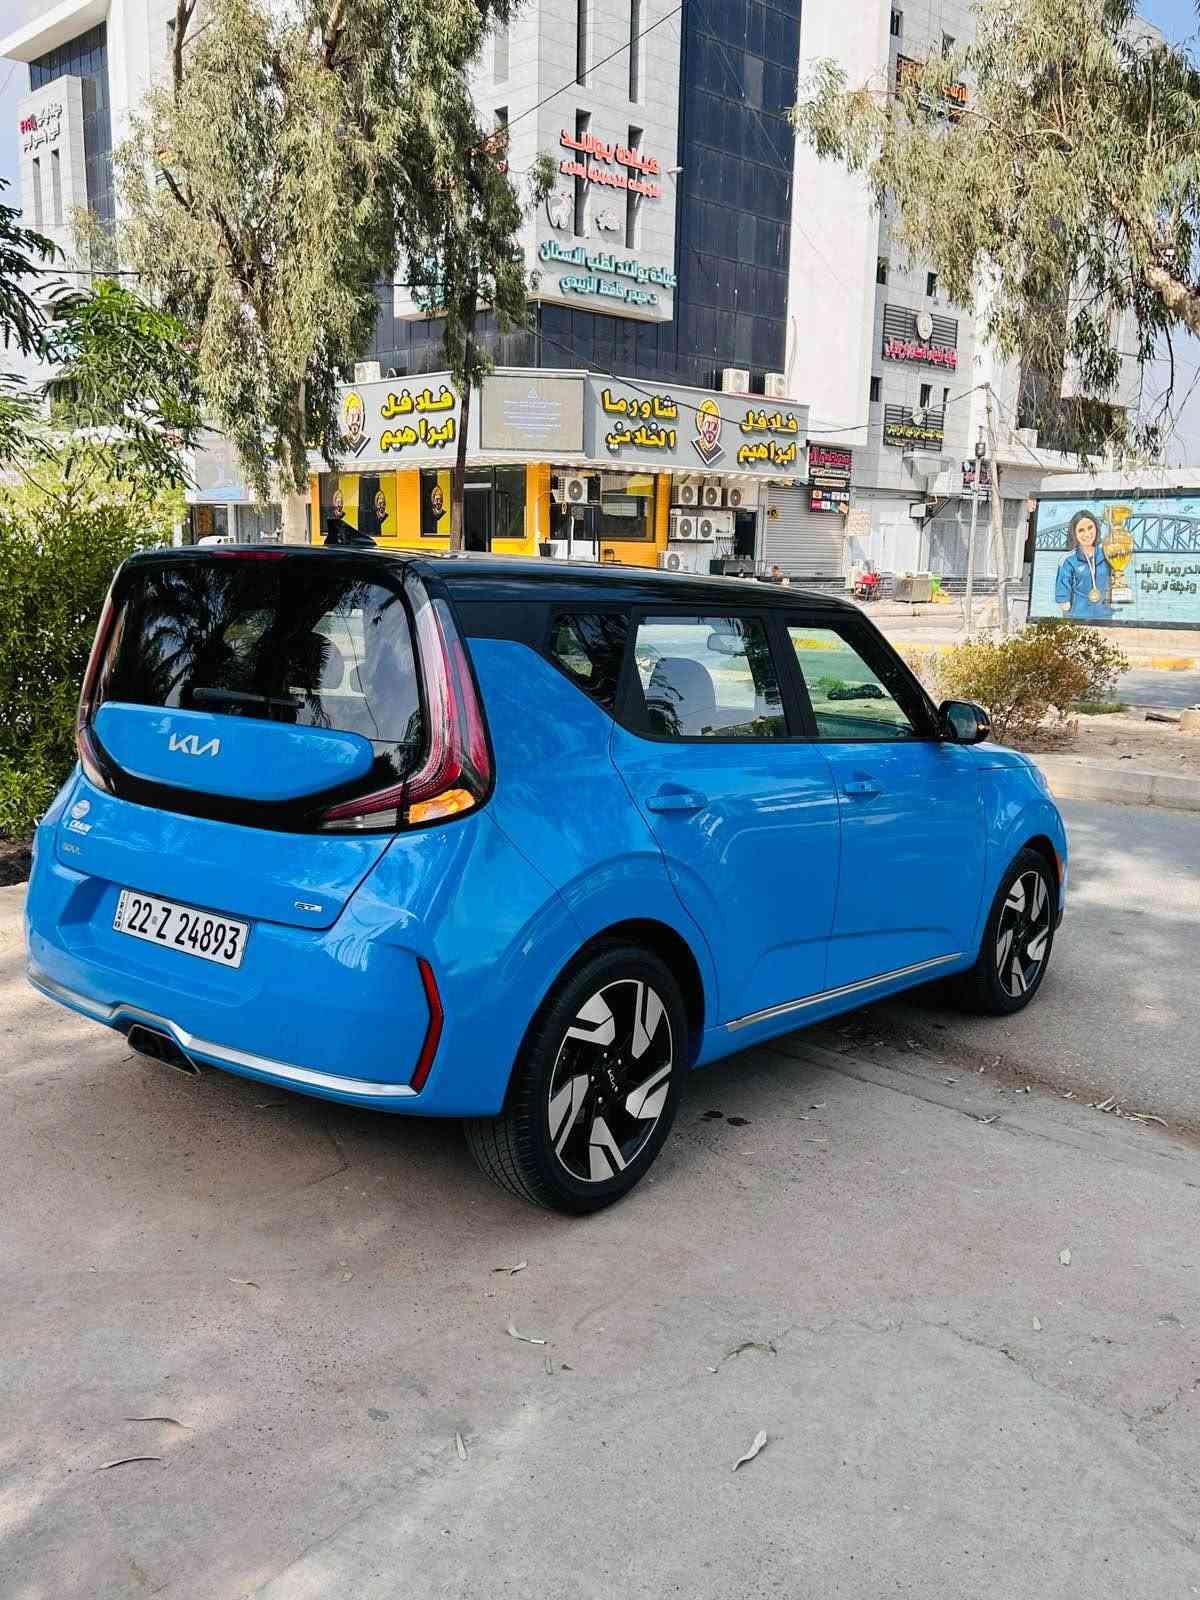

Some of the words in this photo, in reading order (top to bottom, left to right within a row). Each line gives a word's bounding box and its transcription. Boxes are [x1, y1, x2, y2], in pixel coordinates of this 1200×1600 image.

[381, 384, 456, 419] فلافل
[601, 388, 679, 418] شاورما
[380, 417, 457, 451] ابراهيم
[740, 408, 799, 434] فلافل
[737, 440, 797, 466] ابراهيم
[127, 899, 153, 934] 22
[156, 906, 172, 940] Z
[174, 912, 241, 961] 24893
